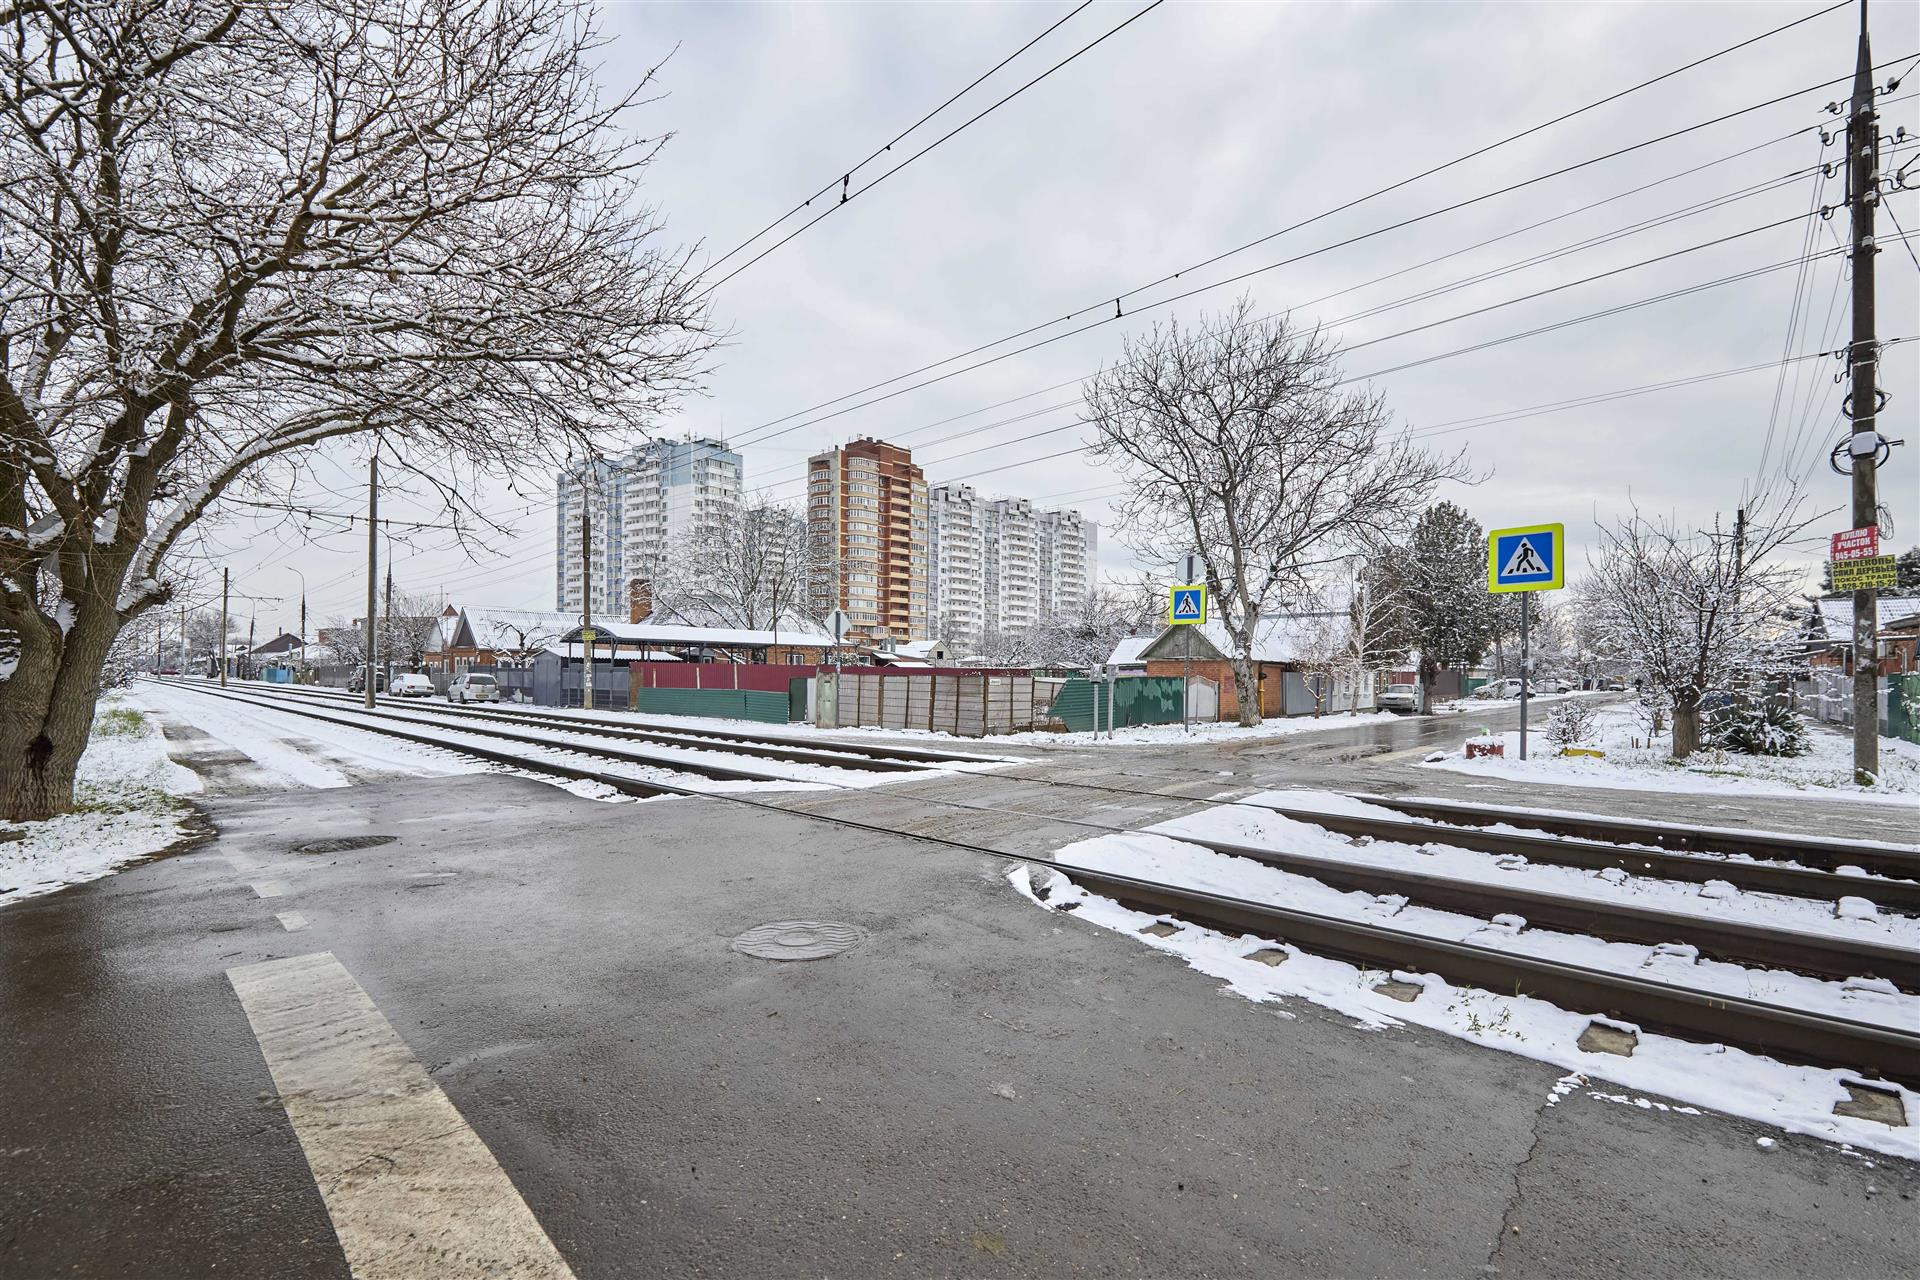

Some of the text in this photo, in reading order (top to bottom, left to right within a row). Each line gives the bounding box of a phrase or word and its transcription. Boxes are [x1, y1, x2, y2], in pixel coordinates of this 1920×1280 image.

[1841, 529, 1867, 540] КУПЛЮ
[1837, 537, 1870, 549] УЧАСТОК
[1833, 557, 1895, 569] ЗЕМЛЕКОПЫ
[1833, 565, 1896, 577] СПИЛ ДЕРЕВЬЕВ
